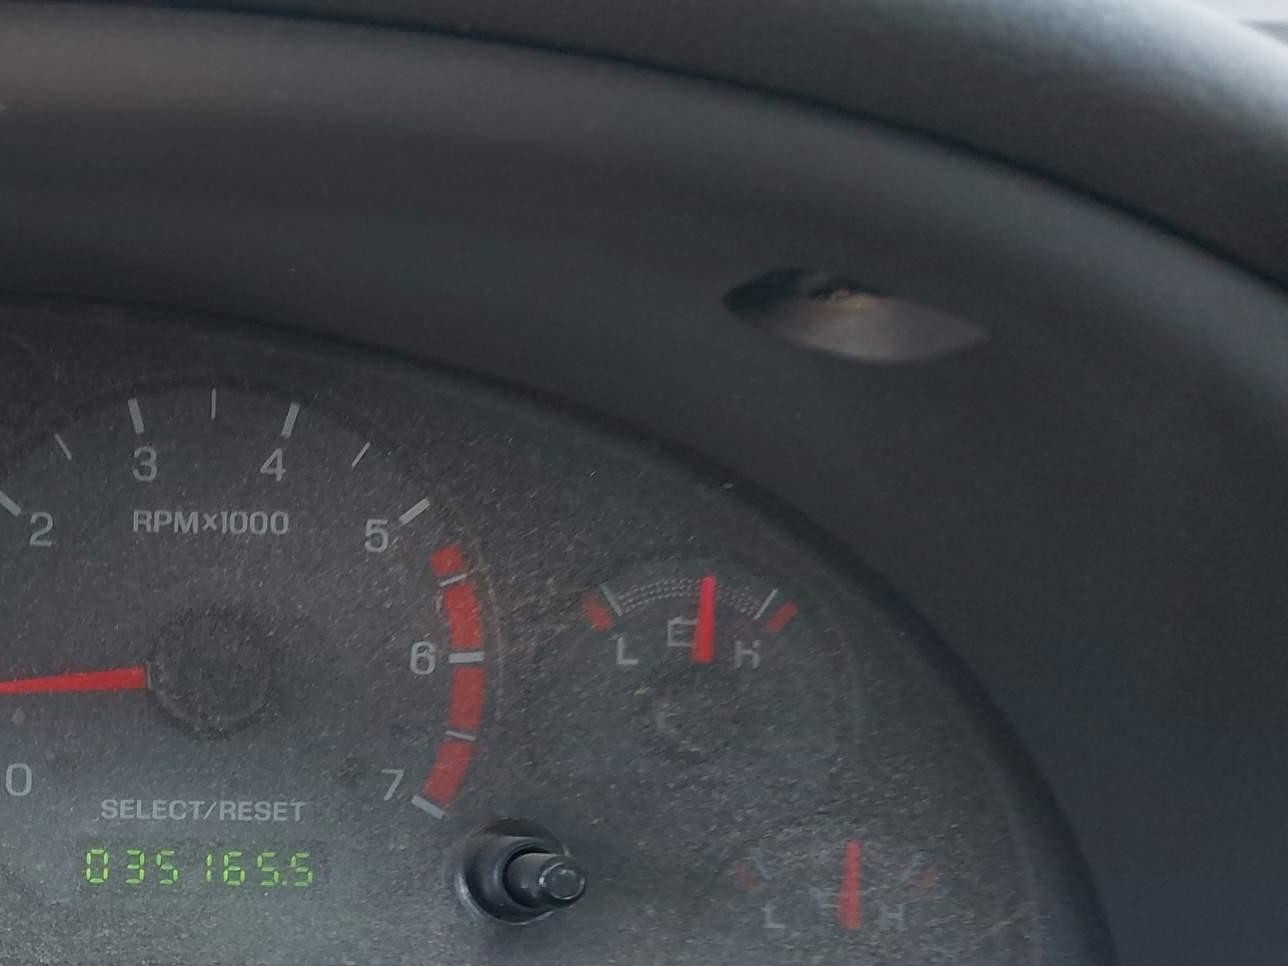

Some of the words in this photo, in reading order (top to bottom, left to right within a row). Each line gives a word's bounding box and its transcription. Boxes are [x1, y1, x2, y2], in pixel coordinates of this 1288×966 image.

[132, 446, 158, 482] 3
[260, 448, 287, 482] 4
[28, 512, 54, 548] 2
[364, 518, 389, 553] 5
[410, 641, 436, 675] 6
[616, 637, 638, 666] L
[5, 763, 33, 798] 0
[381, 769, 405, 801] 7
[101, 799, 306, 822] SELECT/RESET
